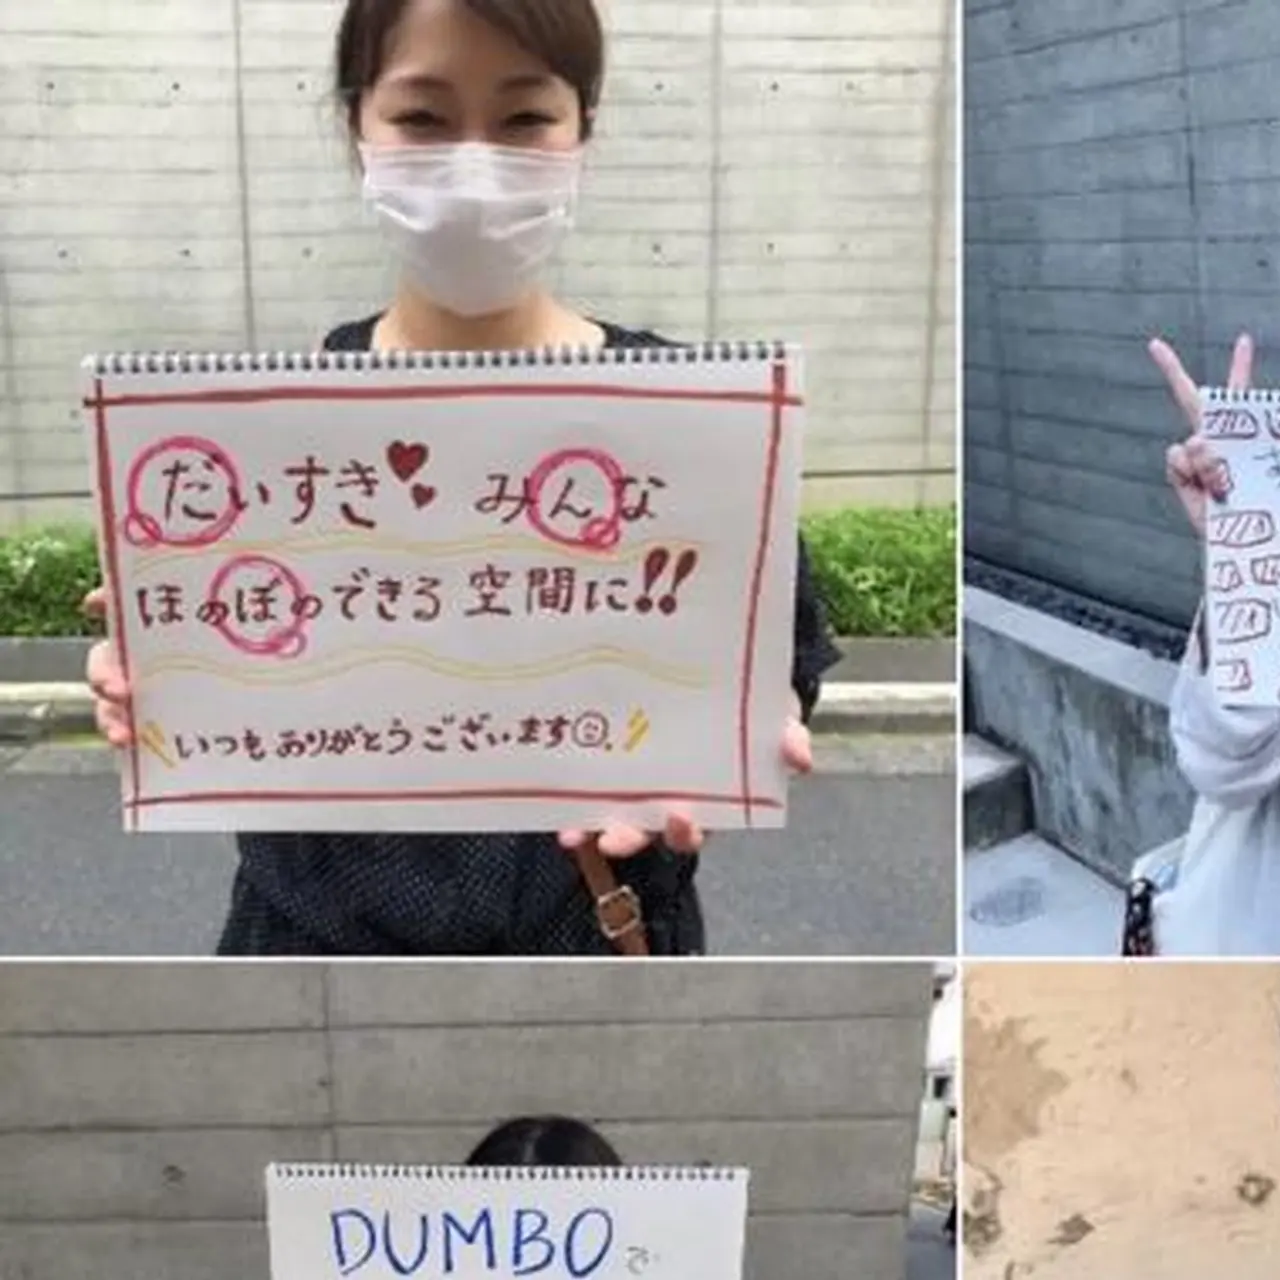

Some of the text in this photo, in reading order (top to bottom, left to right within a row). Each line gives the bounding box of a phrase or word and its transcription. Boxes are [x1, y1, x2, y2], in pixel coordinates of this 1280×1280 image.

[161, 454, 668, 529] だいすき みんな
[174, 710, 572, 762] いつもありがとうございます
